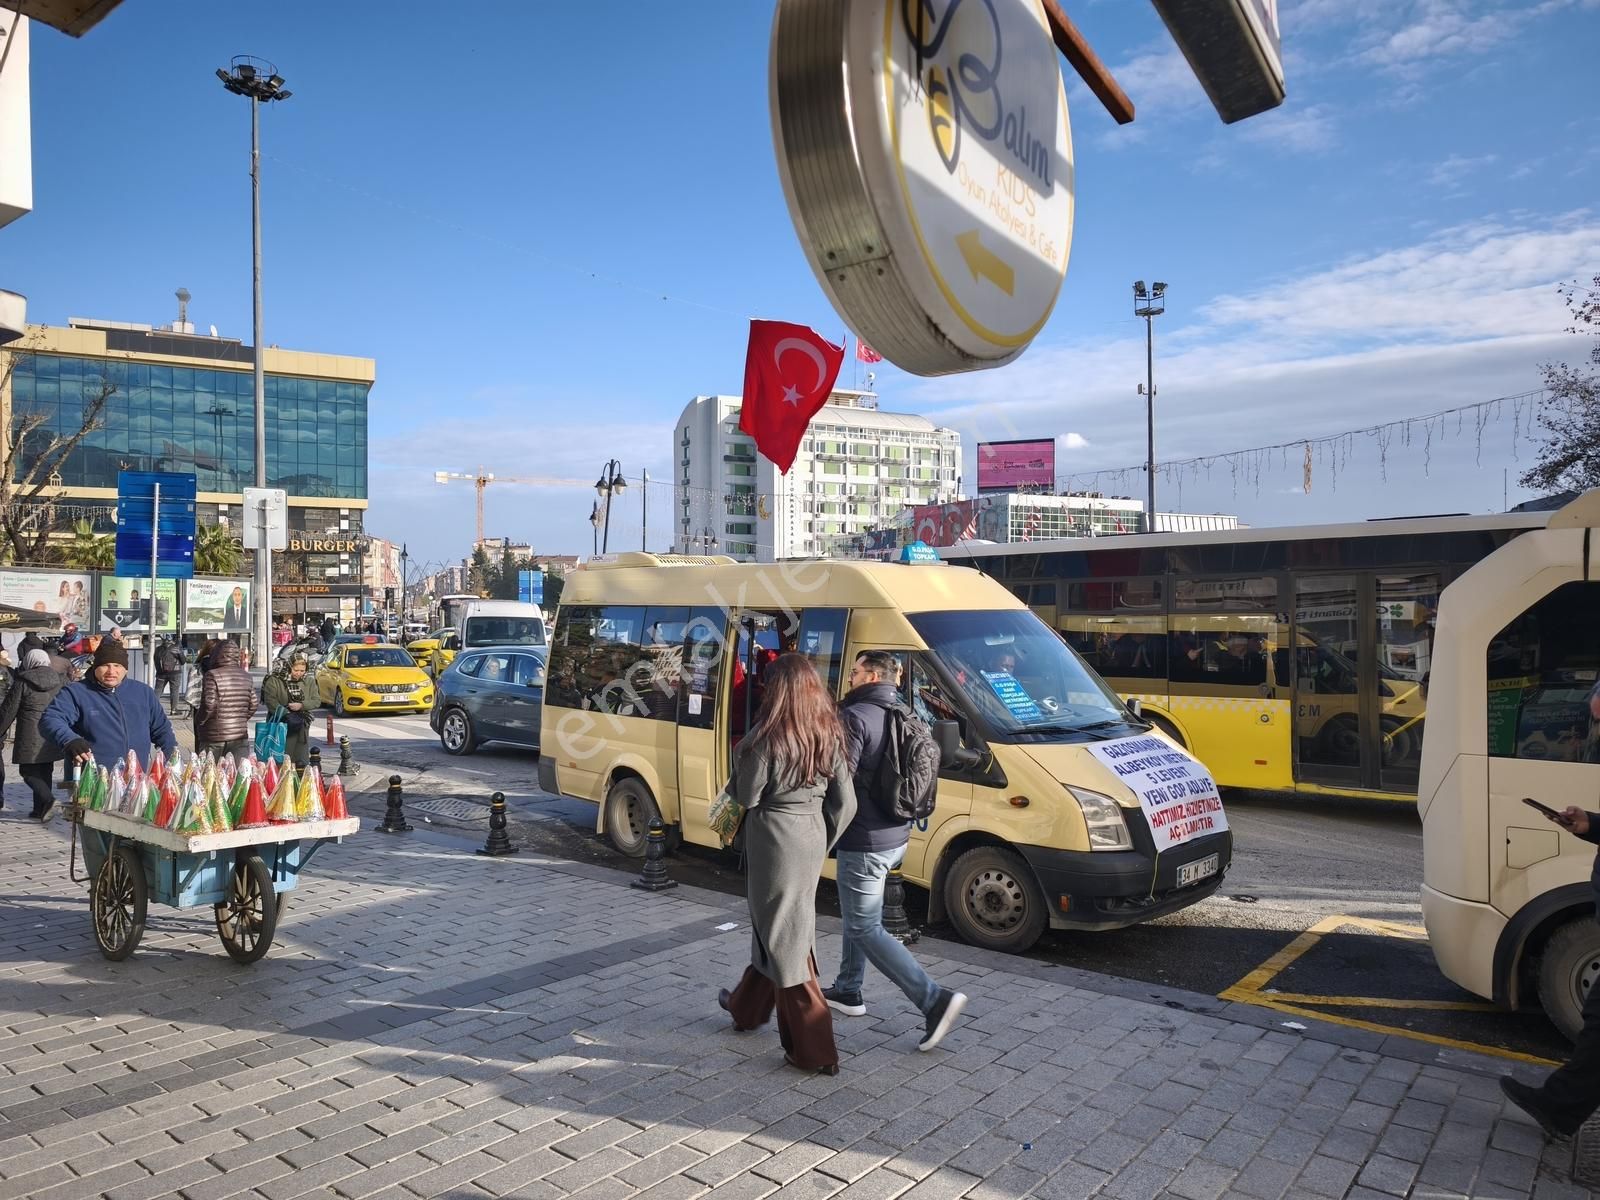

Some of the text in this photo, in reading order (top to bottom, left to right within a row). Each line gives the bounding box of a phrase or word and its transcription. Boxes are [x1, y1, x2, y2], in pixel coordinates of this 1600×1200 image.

[958, 160, 986, 206] Oyun
[997, 163, 1036, 217] KIDS
[290, 539, 356, 552] BURGER
[1146, 766, 1192, 785] 5 LEVENT
[1150, 804, 1186, 829] HATTIMIZ
[1182, 868, 1191, 883] 34
